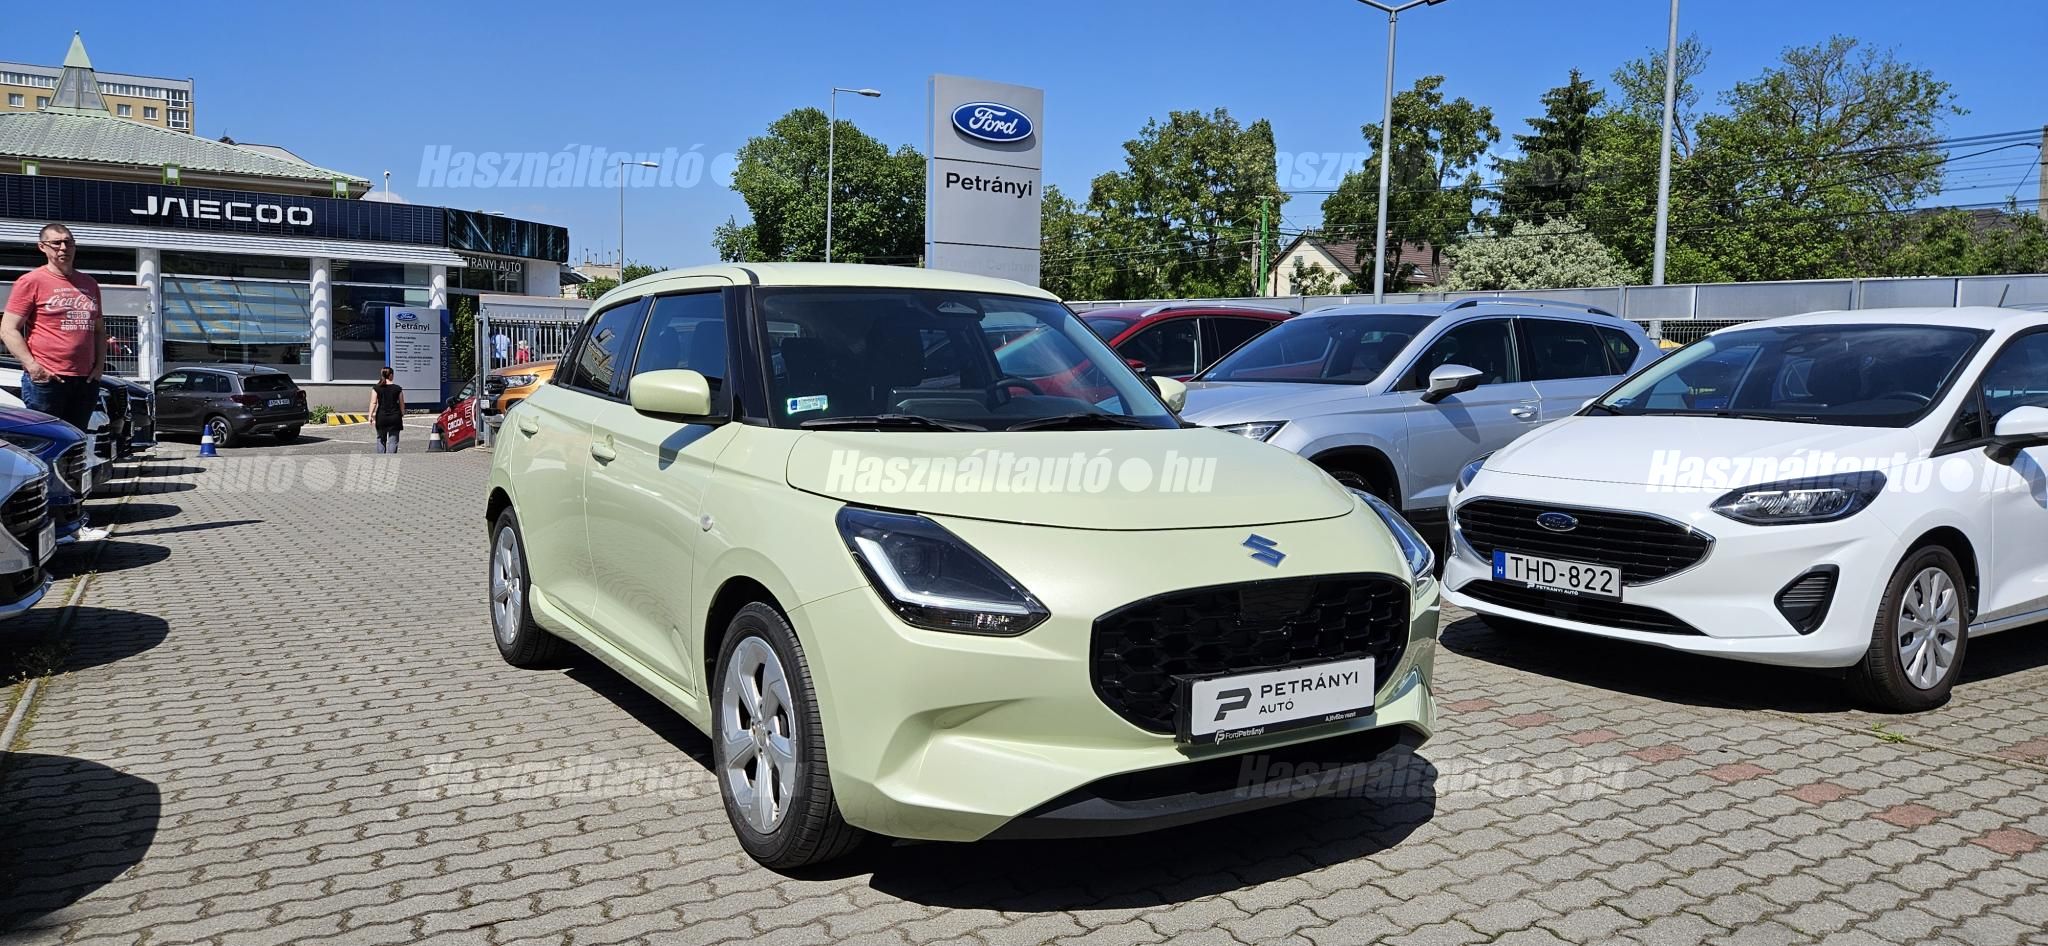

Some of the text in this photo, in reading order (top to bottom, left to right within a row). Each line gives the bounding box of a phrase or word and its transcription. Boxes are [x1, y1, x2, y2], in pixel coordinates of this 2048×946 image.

[969, 106, 1019, 135] Ford
[945, 171, 1033, 199] Petrányi
[130, 195, 313, 226] JAECOO
[465, 255, 497, 270] TRÁNYI
[395, 322, 430, 332] Petrányi
[1510, 556, 1613, 594] THD-822
[1260, 671, 1359, 699] PETRÁNYI
[1258, 700, 1294, 715] AUTÓ
